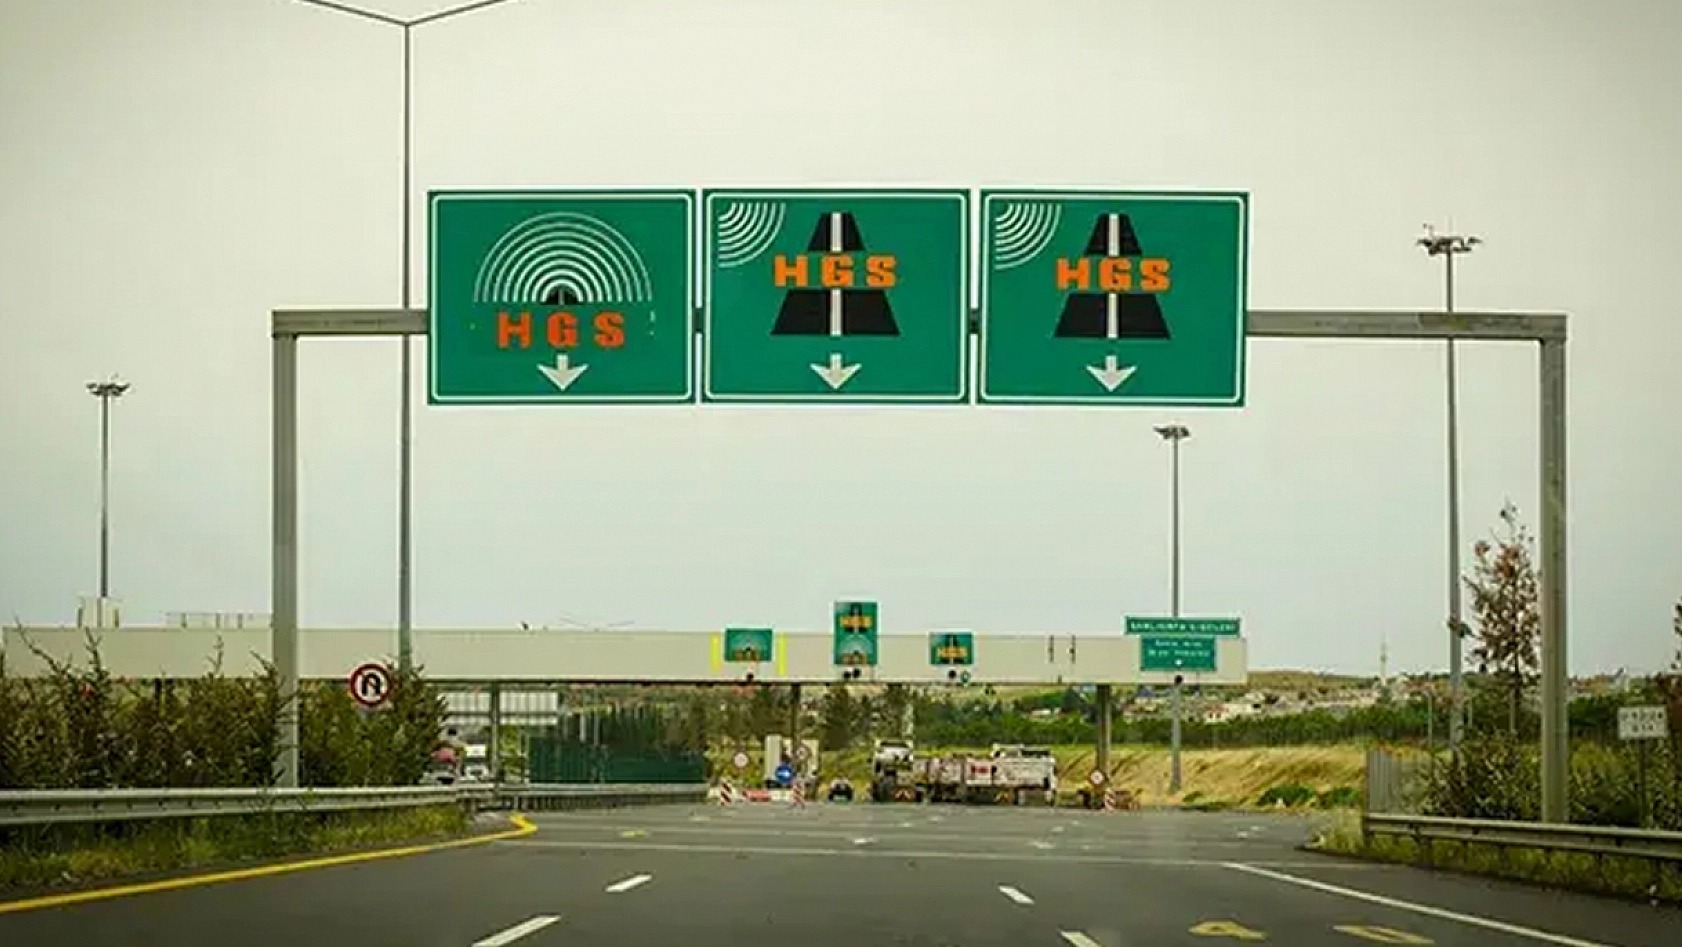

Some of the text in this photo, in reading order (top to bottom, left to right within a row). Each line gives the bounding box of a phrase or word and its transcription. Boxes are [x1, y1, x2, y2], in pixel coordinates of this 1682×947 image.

[775, 256, 895, 287] HGS
[1057, 258, 1169, 290] HGS
[496, 311, 625, 348] HGS
